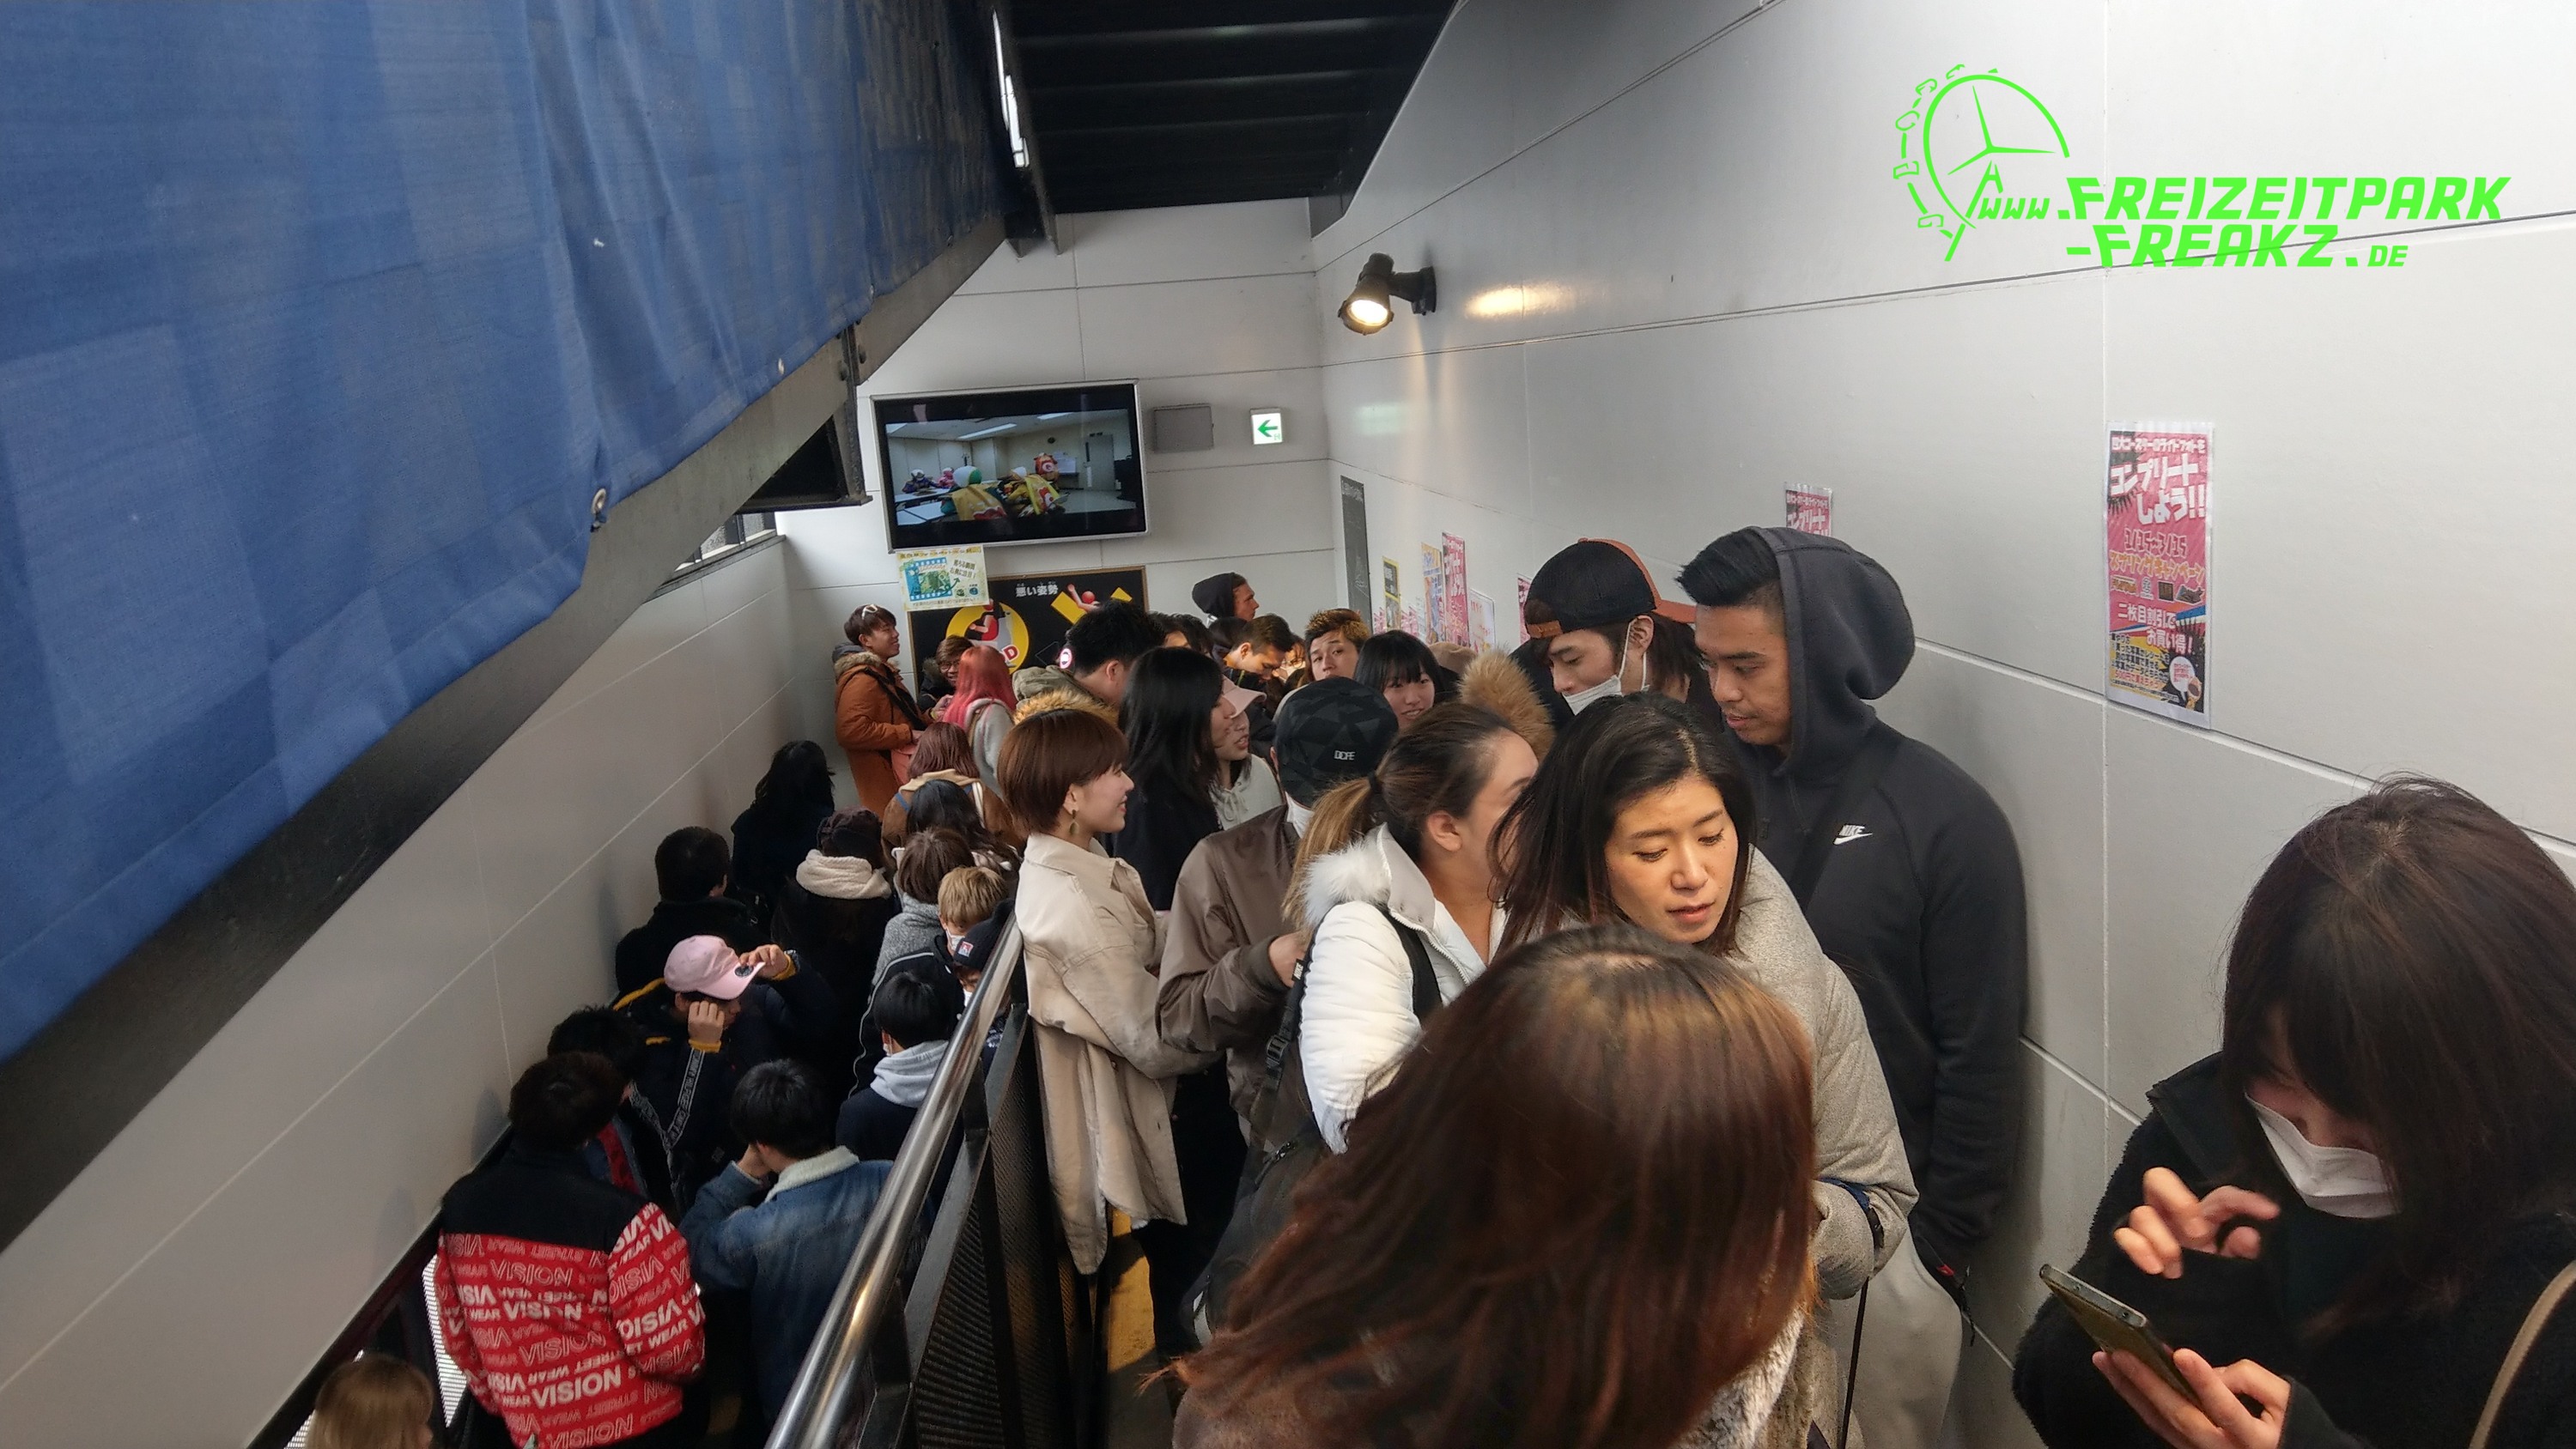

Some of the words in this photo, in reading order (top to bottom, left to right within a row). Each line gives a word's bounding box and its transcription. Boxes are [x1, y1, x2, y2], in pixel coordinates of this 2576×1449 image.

[2111, 453, 2198, 496] コンプリート
[2117, 602, 2177, 629] 二枚目割引で
[1334, 749, 1356, 761] DOPE
[1838, 824, 1866, 837] NIKE
[490, 1258, 574, 1288] VISION
[609, 1254, 665, 1306] VISIO
[519, 1331, 606, 1367] VISION
[532, 1364, 622, 1410] VISION
